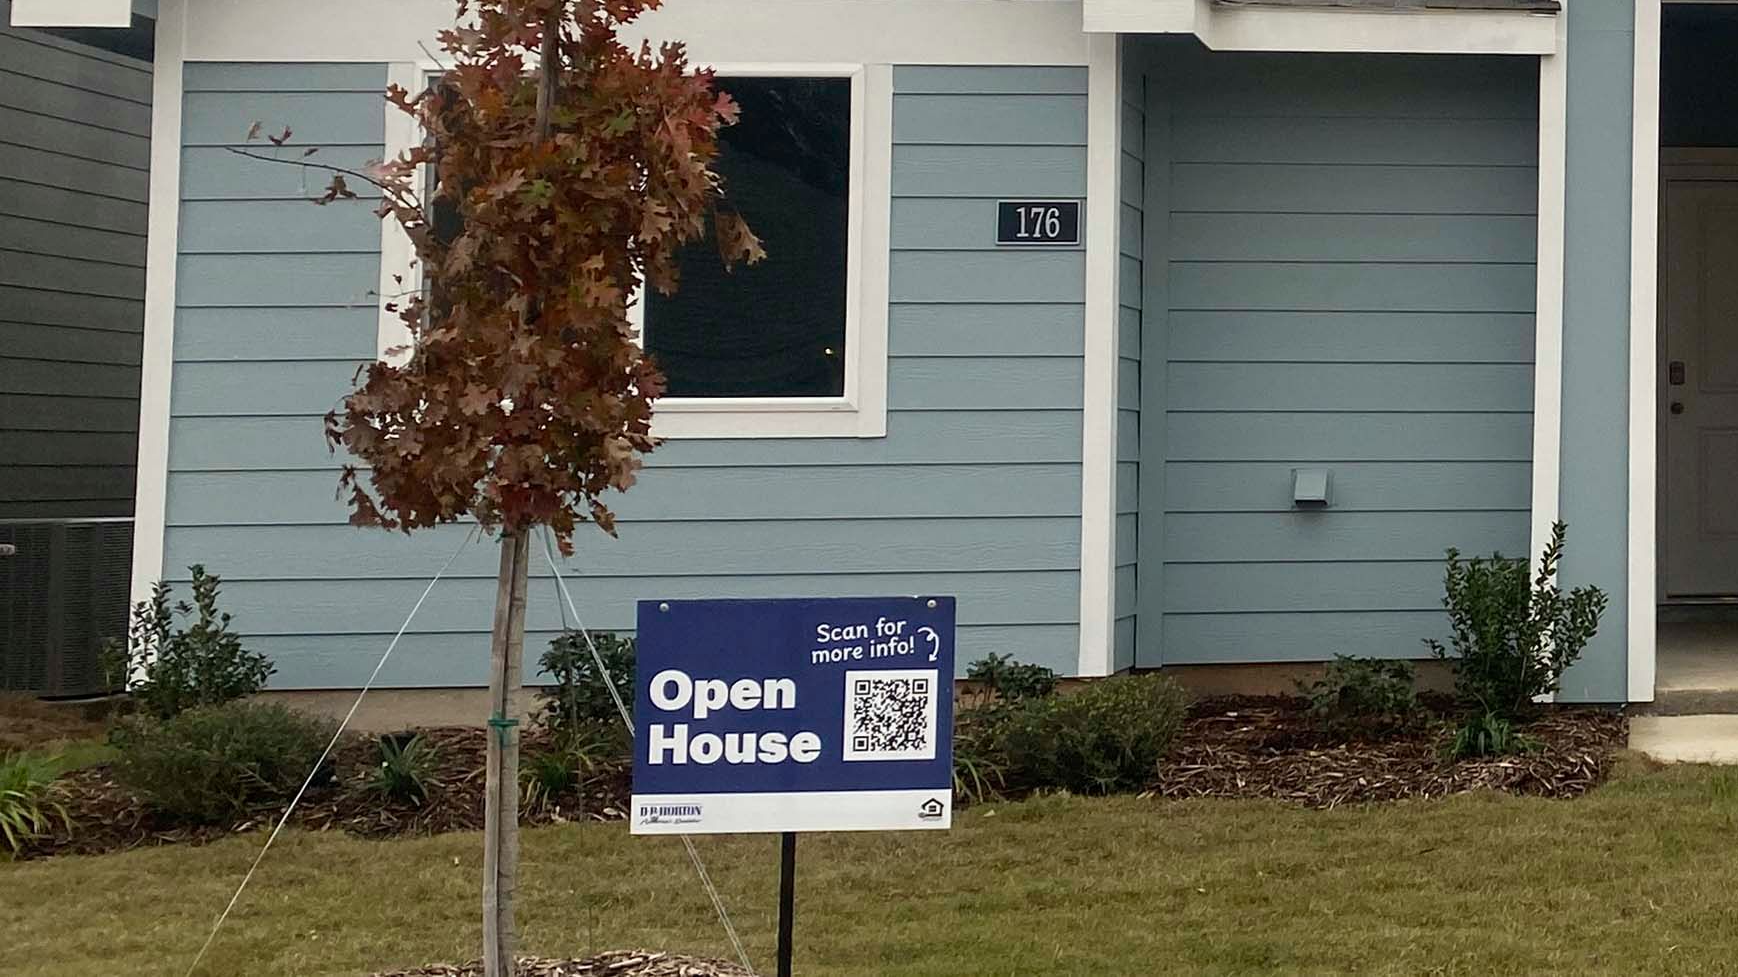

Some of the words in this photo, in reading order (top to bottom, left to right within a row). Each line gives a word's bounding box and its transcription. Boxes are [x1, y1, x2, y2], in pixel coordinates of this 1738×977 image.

[1016, 207, 1060, 237] 176
[817, 624, 868, 642] Scan
[876, 617, 906, 637] for
[811, 646, 863, 664] more
[870, 636, 914, 657] info!
[649, 669, 796, 719] Open
[648, 723, 822, 765] House
